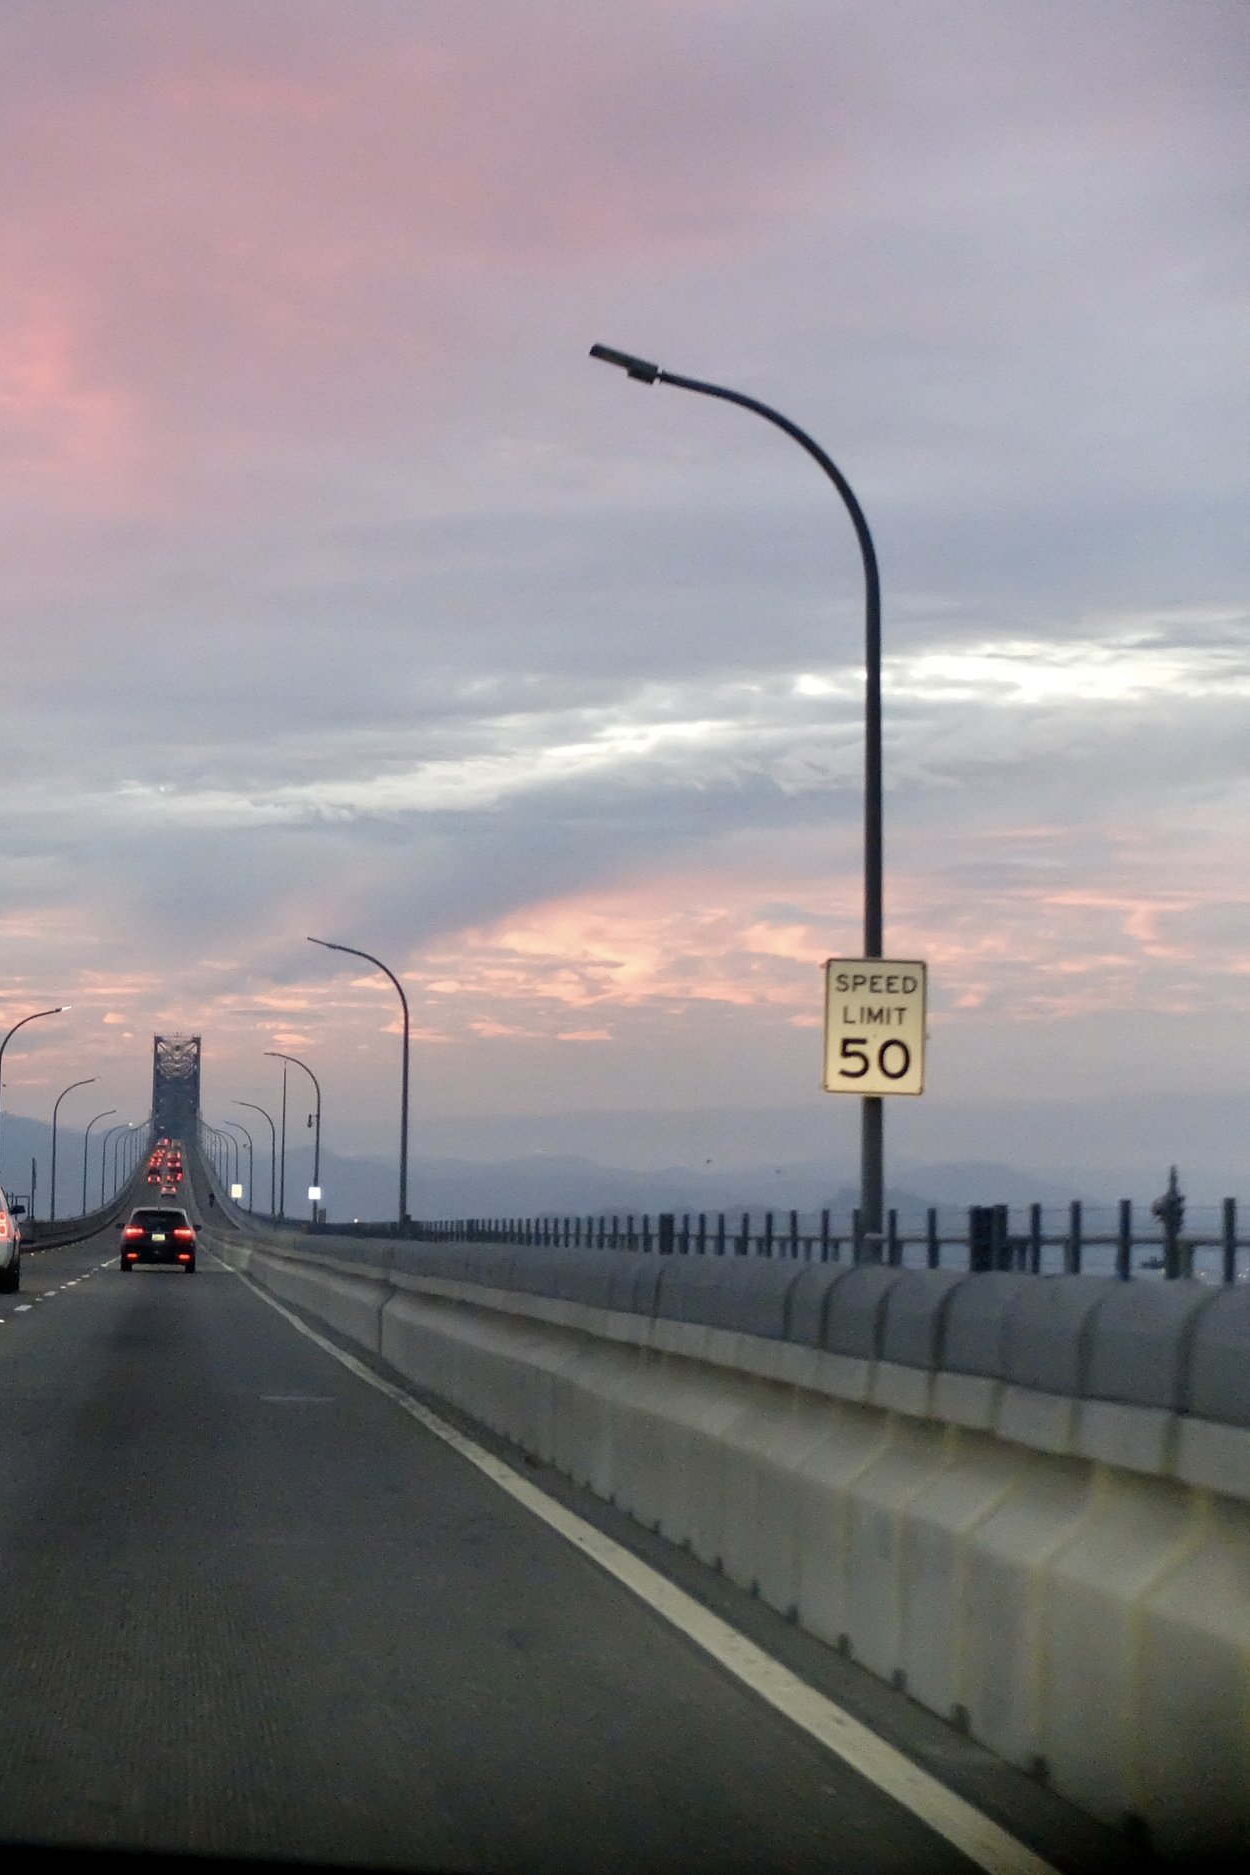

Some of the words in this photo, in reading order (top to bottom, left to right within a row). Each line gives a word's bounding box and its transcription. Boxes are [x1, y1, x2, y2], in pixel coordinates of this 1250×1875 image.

[836, 974, 918, 995] SPEED
[843, 1005, 907, 1026] LIMIT
[838, 1038, 911, 1080] 50
